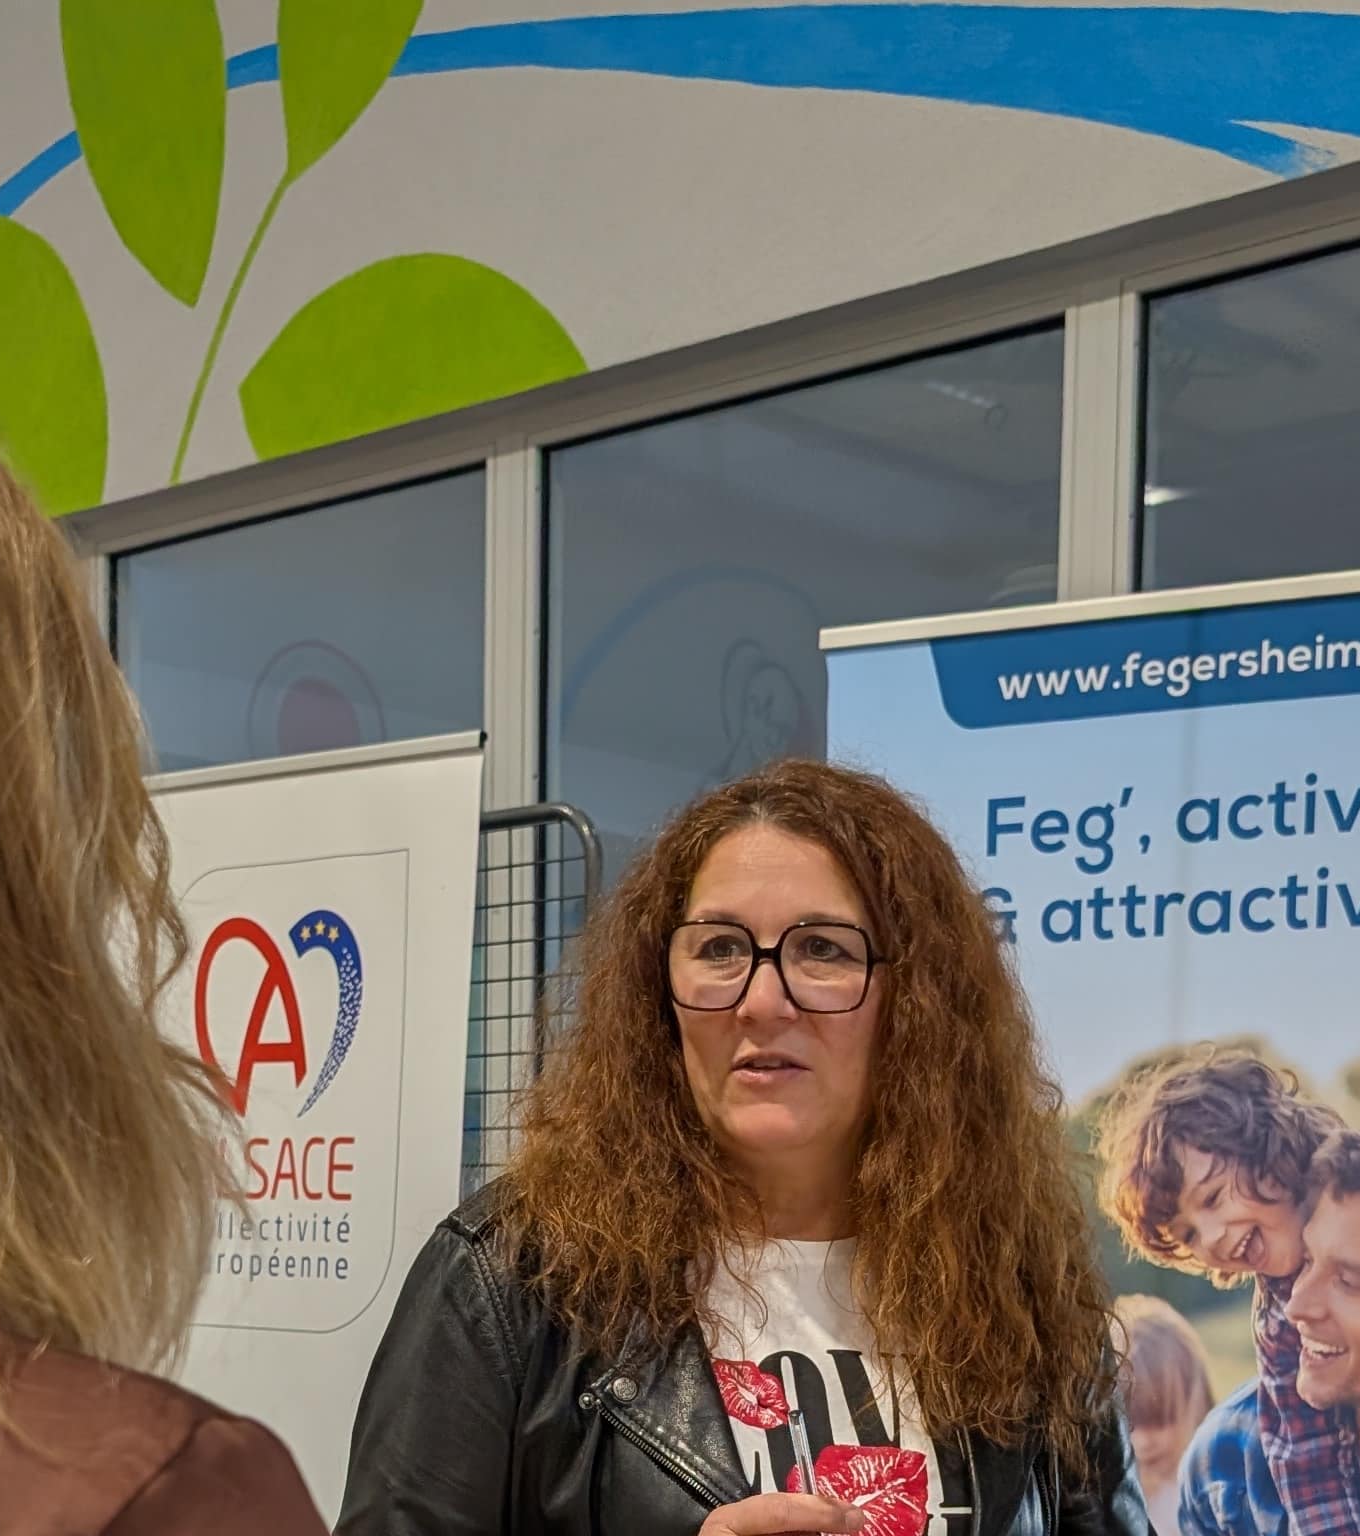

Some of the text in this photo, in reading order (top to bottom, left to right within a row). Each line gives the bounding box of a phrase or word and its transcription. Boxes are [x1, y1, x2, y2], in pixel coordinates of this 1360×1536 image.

[220, 1136, 355, 1202] SACE
[217, 1212, 351, 1242] llectivité
[216, 1248, 349, 1282] ropéenne
